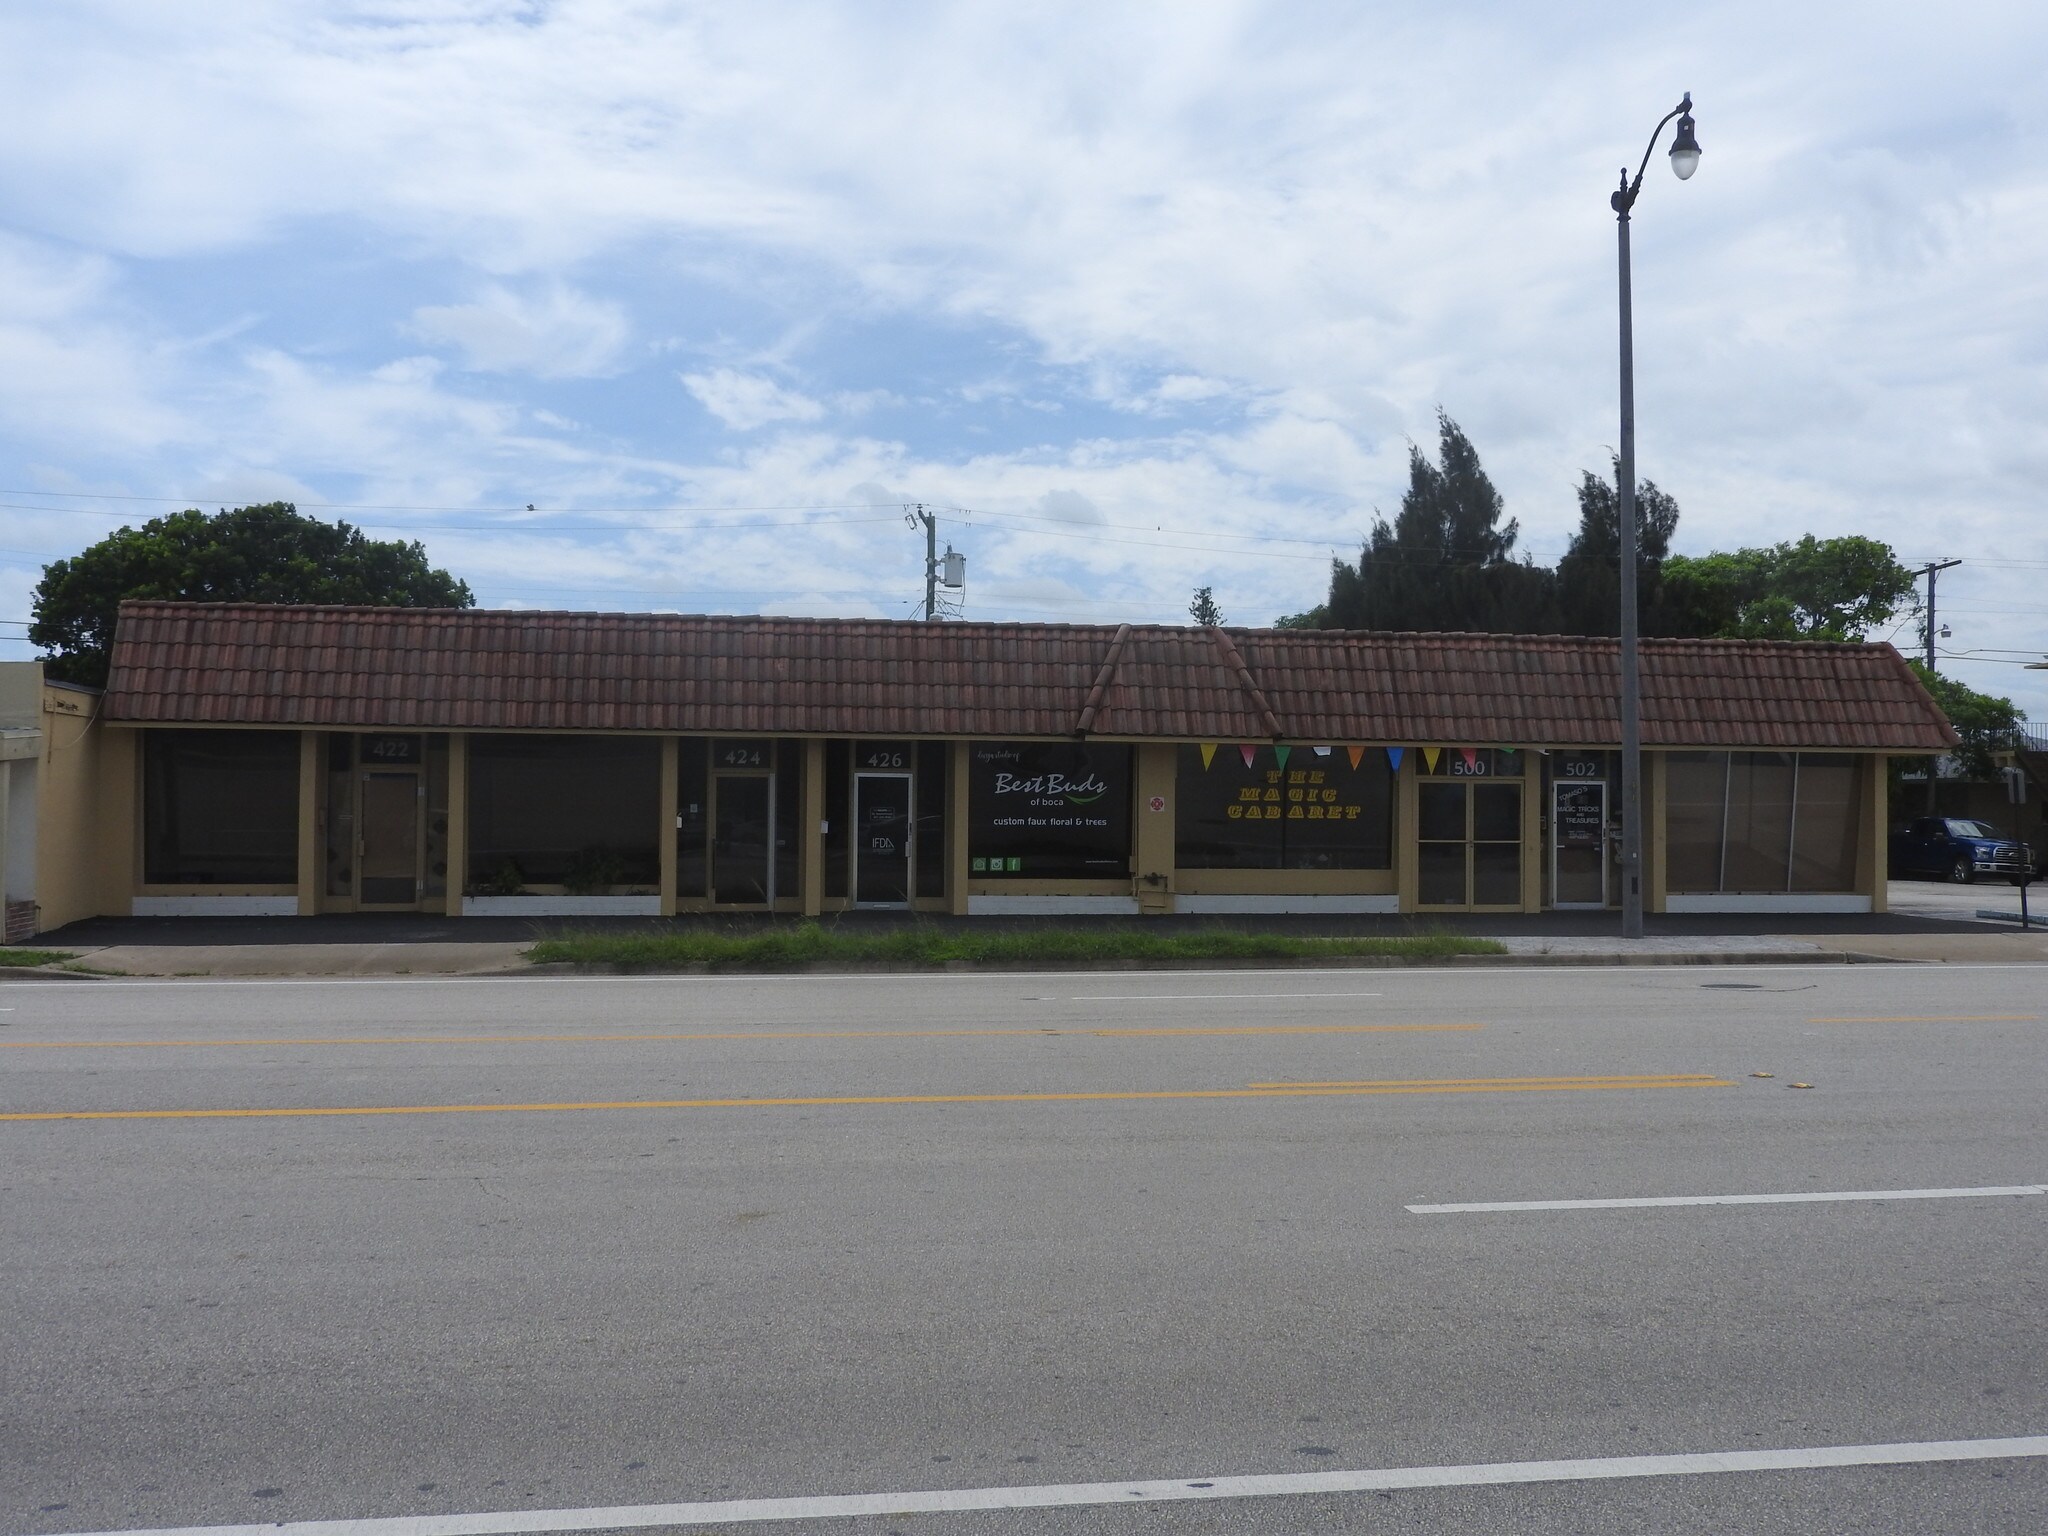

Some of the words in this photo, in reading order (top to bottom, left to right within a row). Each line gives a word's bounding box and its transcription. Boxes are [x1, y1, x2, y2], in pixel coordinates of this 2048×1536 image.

[372, 741, 409, 757] 422
[725, 749, 761, 765] 424
[867, 753, 902, 767] 426
[1454, 761, 1485, 775] 500
[1566, 762, 1595, 776] 502
[994, 773, 1045, 794] Best
[1046, 773, 1108, 795] Buds
[1266, 770, 1325, 784] THE
[1238, 787, 1337, 802] MAGIC
[1030, 798, 1040, 806] of
[1042, 798, 1064, 806] boca
[1227, 805, 1361, 819] CABARET
[993, 817, 1025, 826] custom
[1028, 817, 1047, 826] faux
[1050, 817, 1073, 826] floral
[1075, 818, 1083, 826] &
[1086, 818, 1107, 826] trees
[872, 837, 895, 849] IFDA
